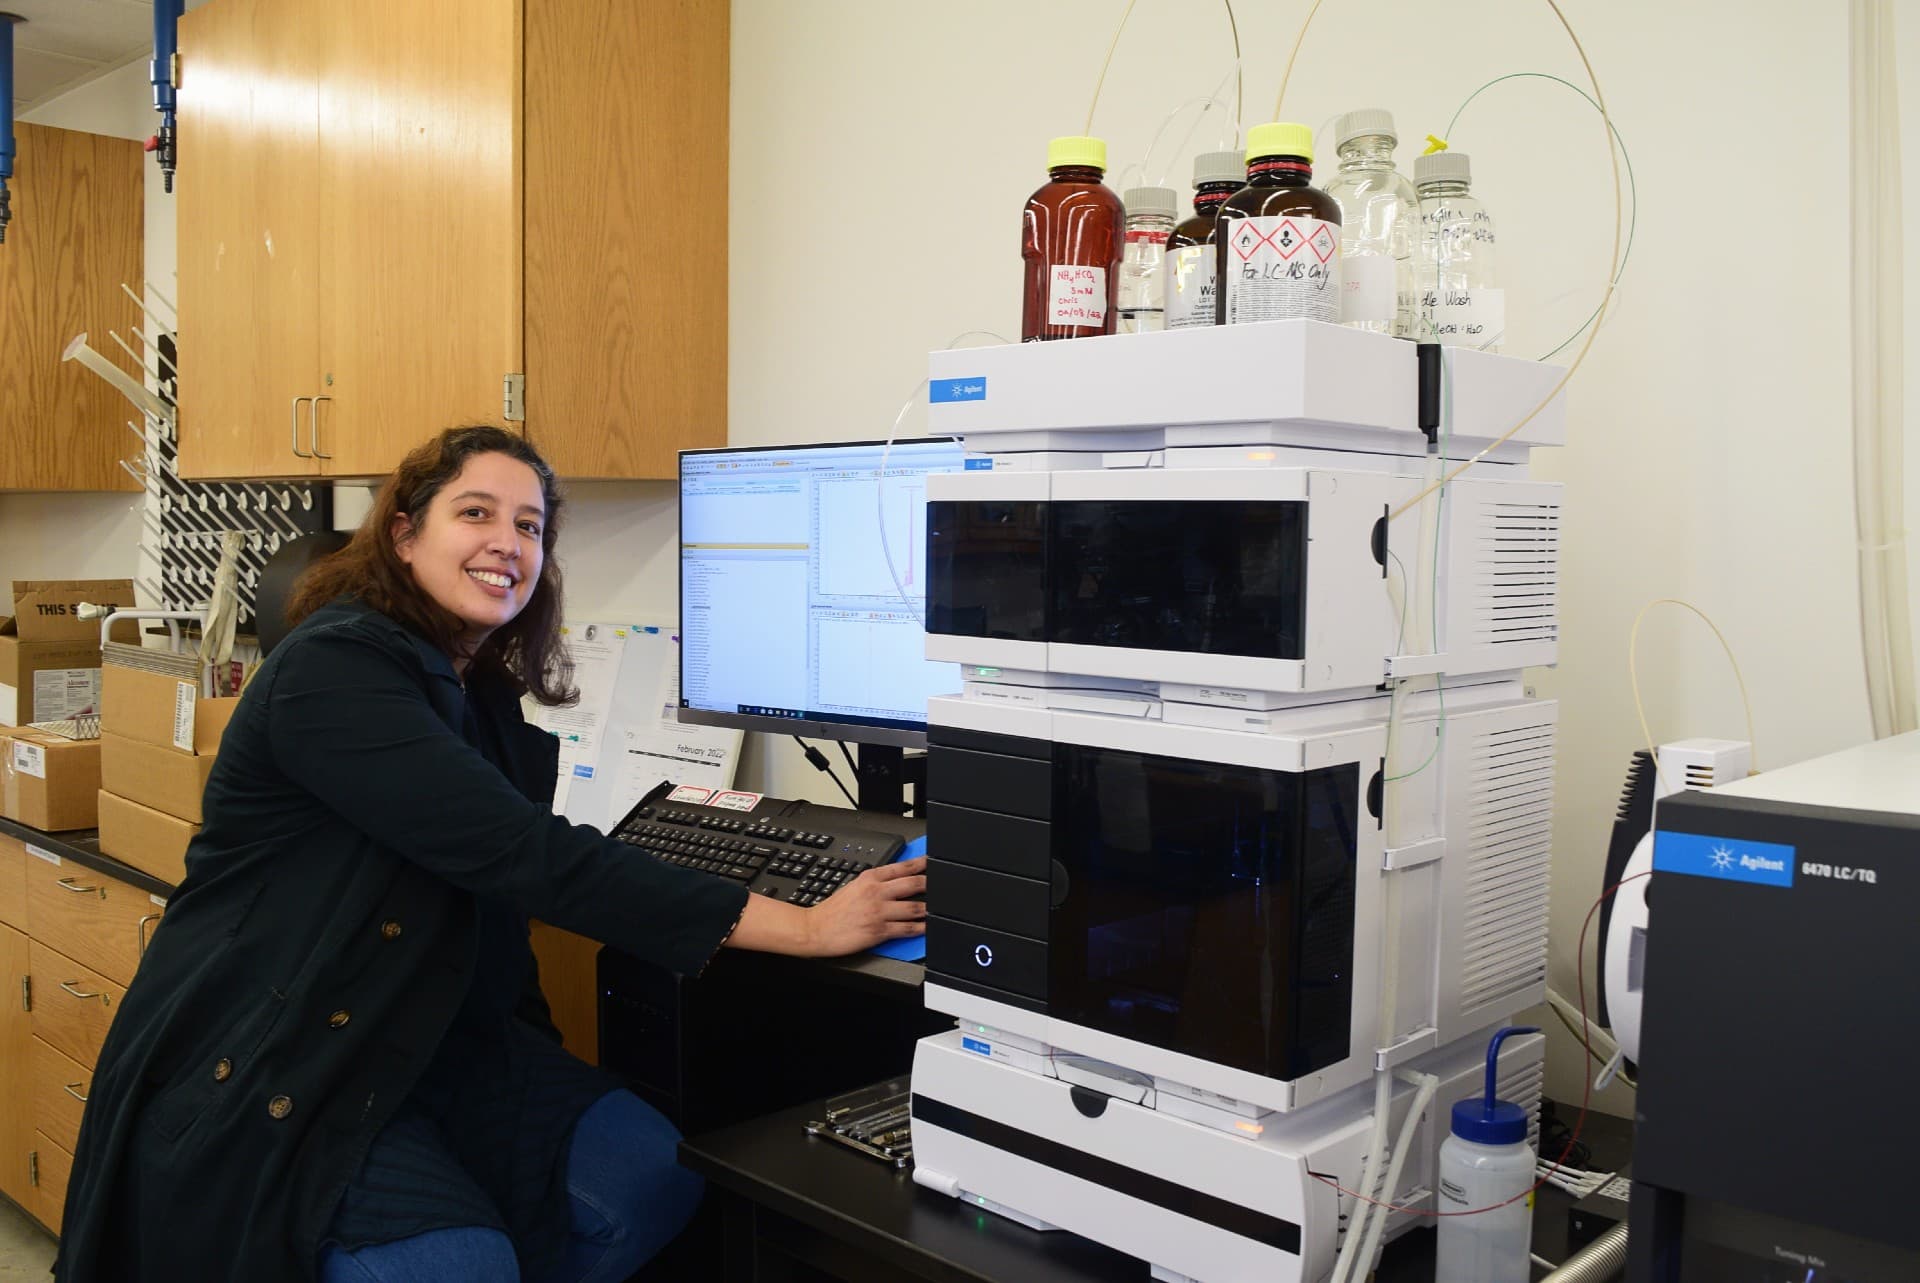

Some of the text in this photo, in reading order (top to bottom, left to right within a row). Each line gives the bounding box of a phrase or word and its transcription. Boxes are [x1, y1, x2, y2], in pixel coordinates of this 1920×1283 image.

[1308, 263, 1330, 291] Only
[36, 604, 66, 616] THIS
[677, 744, 705, 757] February
[1739, 854, 1784, 872] Agilent
[1833, 865, 1878, 884] LC/TQ
